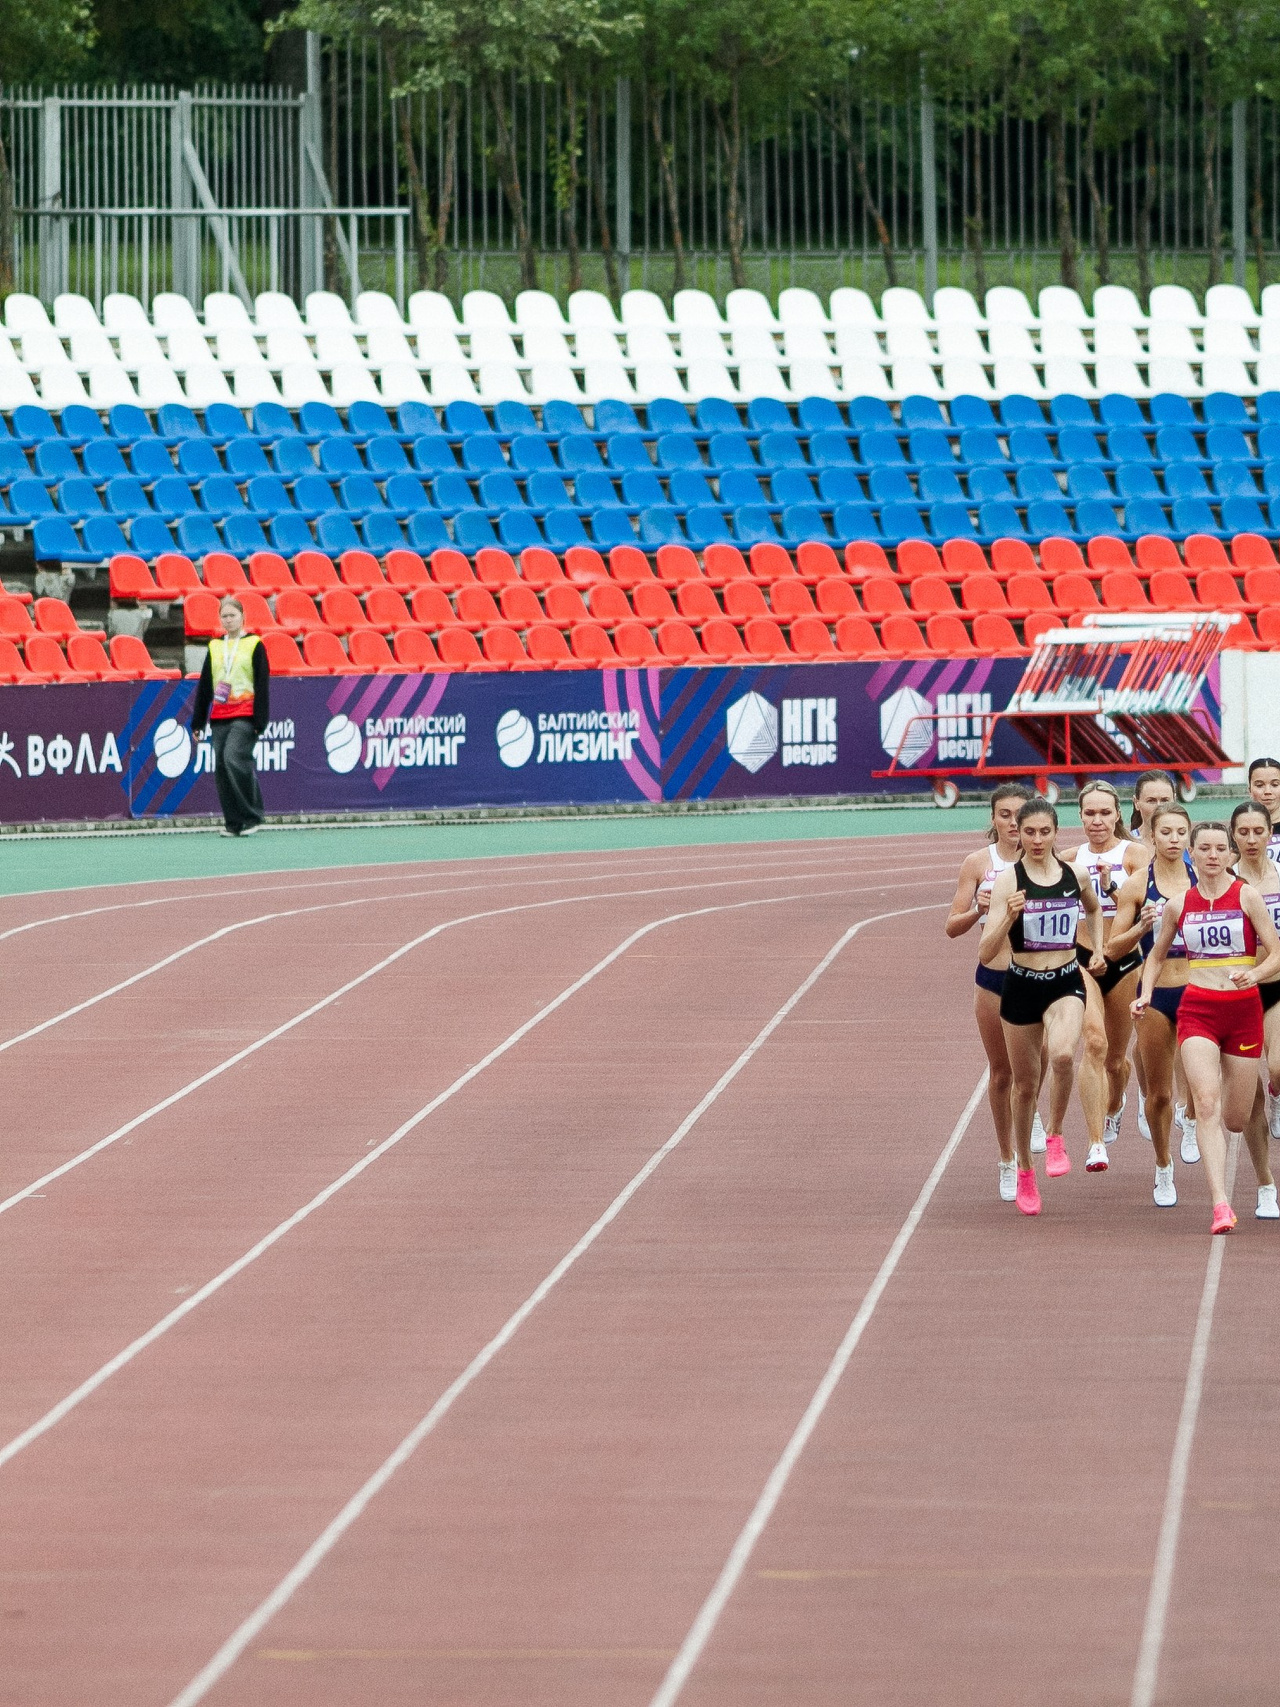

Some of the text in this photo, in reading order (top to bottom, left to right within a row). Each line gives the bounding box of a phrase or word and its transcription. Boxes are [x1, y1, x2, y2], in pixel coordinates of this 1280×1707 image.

[364, 713, 466, 736] БАЛТИЙСКИЙ
[538, 709, 640, 732] БАЛТИЙСКИЙ
[782, 697, 837, 743] НГК
[27, 732, 123, 776] ВФЛА
[193, 741, 295, 774] ЛИНГ
[364, 736, 466, 769] ЛИЗИНГ
[537, 731, 640, 763] ЛИЗИНГ
[782, 744, 837, 767] ресурс
[1038, 913, 1071, 937] 110
[1197, 926, 1232, 948] 189
[1025, 970, 1056, 980] PRO
